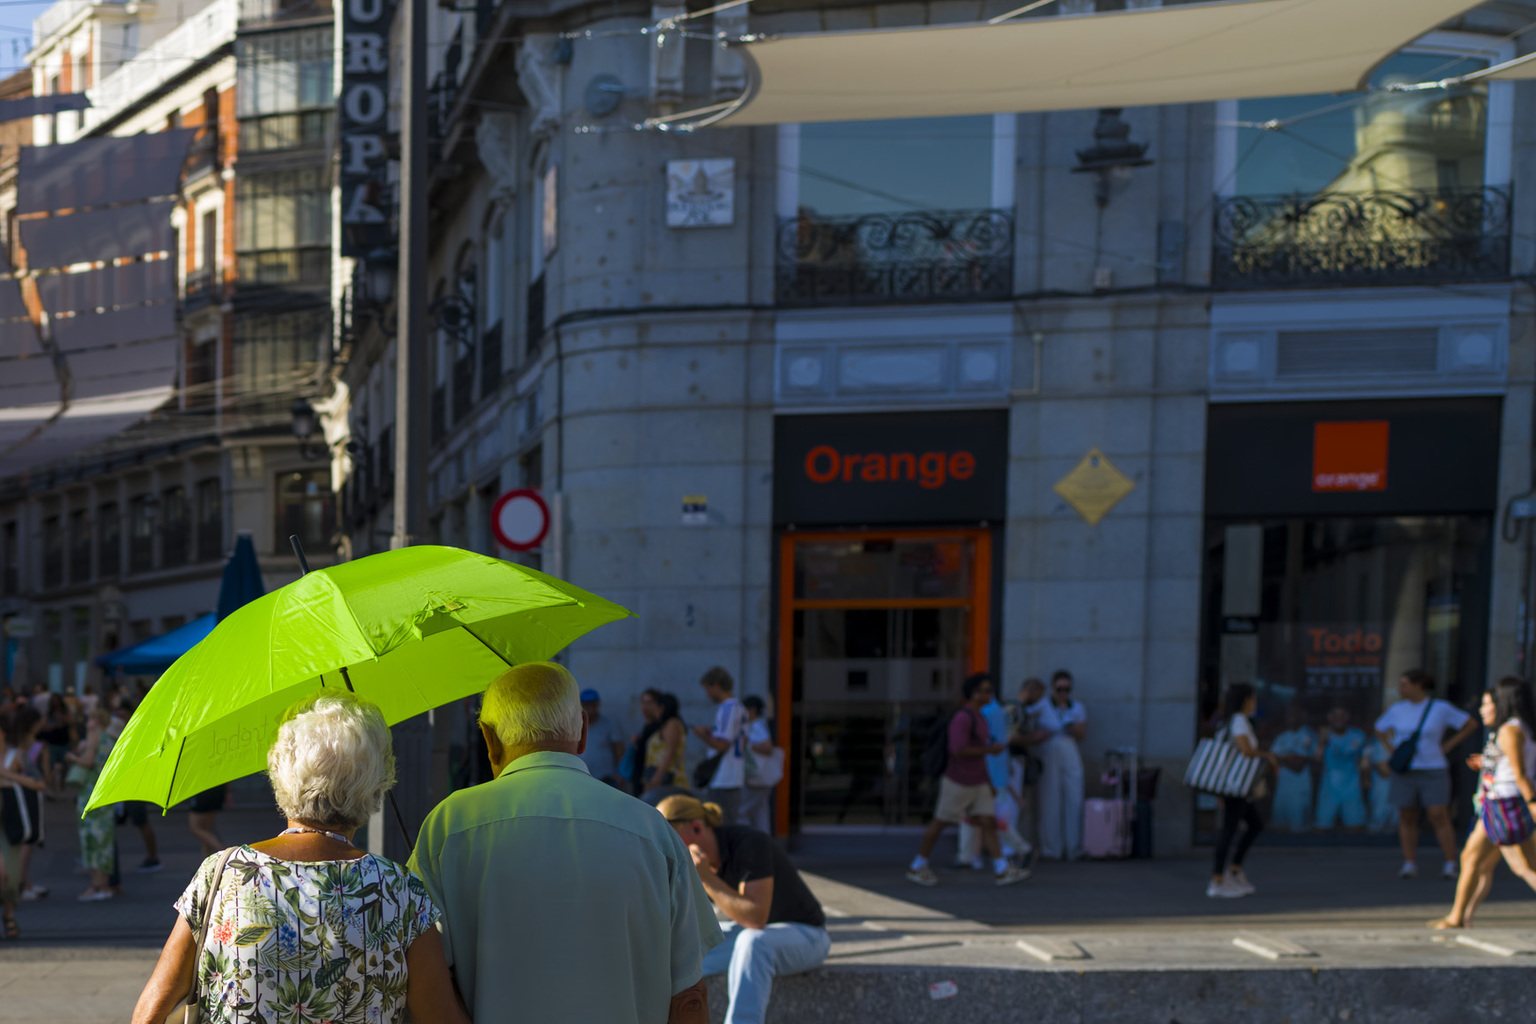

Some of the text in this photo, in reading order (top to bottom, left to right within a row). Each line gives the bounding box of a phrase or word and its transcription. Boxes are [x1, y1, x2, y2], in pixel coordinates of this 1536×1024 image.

[804, 444, 977, 490] Orange
[1315, 472, 1380, 491] orange
[1307, 627, 1383, 653] Todo
